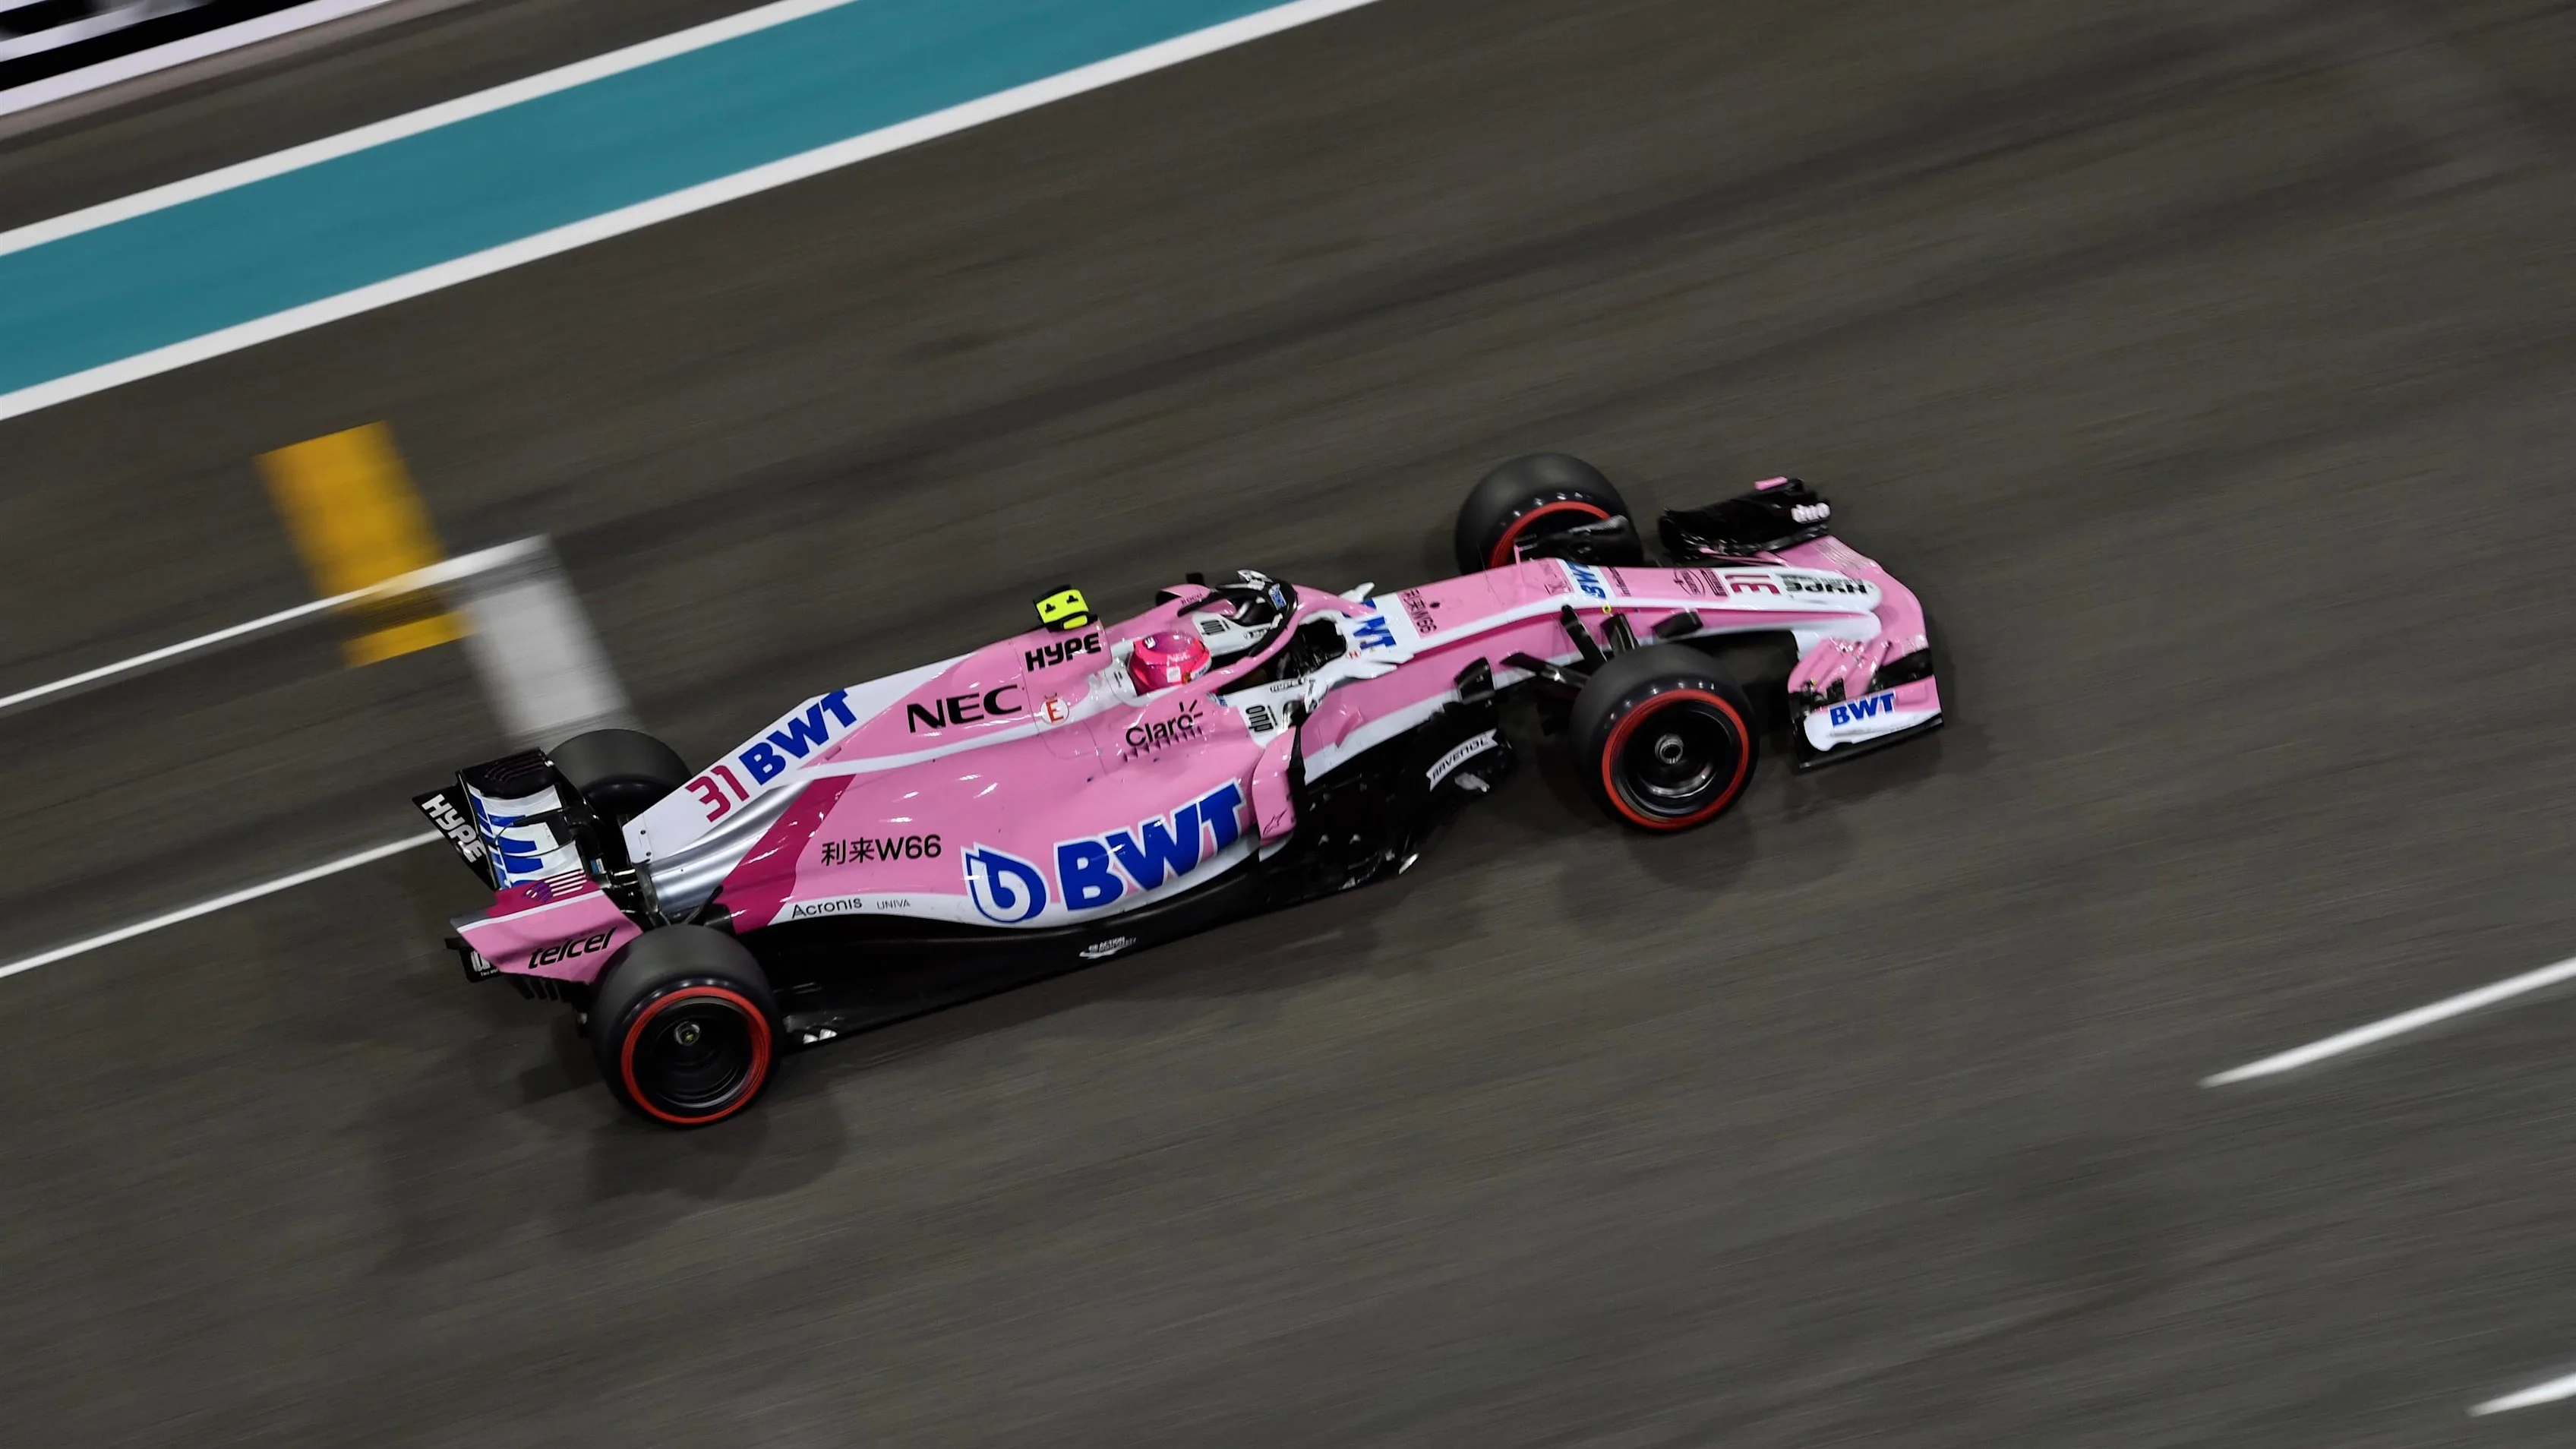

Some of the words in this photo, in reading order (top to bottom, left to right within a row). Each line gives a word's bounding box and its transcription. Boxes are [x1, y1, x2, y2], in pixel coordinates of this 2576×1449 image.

[1725, 574, 1781, 595] 31
[1025, 632, 1101, 672] HYPE
[907, 685, 1022, 733] NEC
[1125, 711, 1194, 748] Claro
[1829, 692, 1896, 727] BWT
[739, 690, 857, 785] BWT
[685, 765, 749, 822] 31
[421, 794, 487, 863] HYPE
[1059, 781, 1244, 911] BWT
[821, 834, 942, 867] 利来W66
[791, 898, 863, 919] Acronis
[528, 927, 617, 969] telcel
